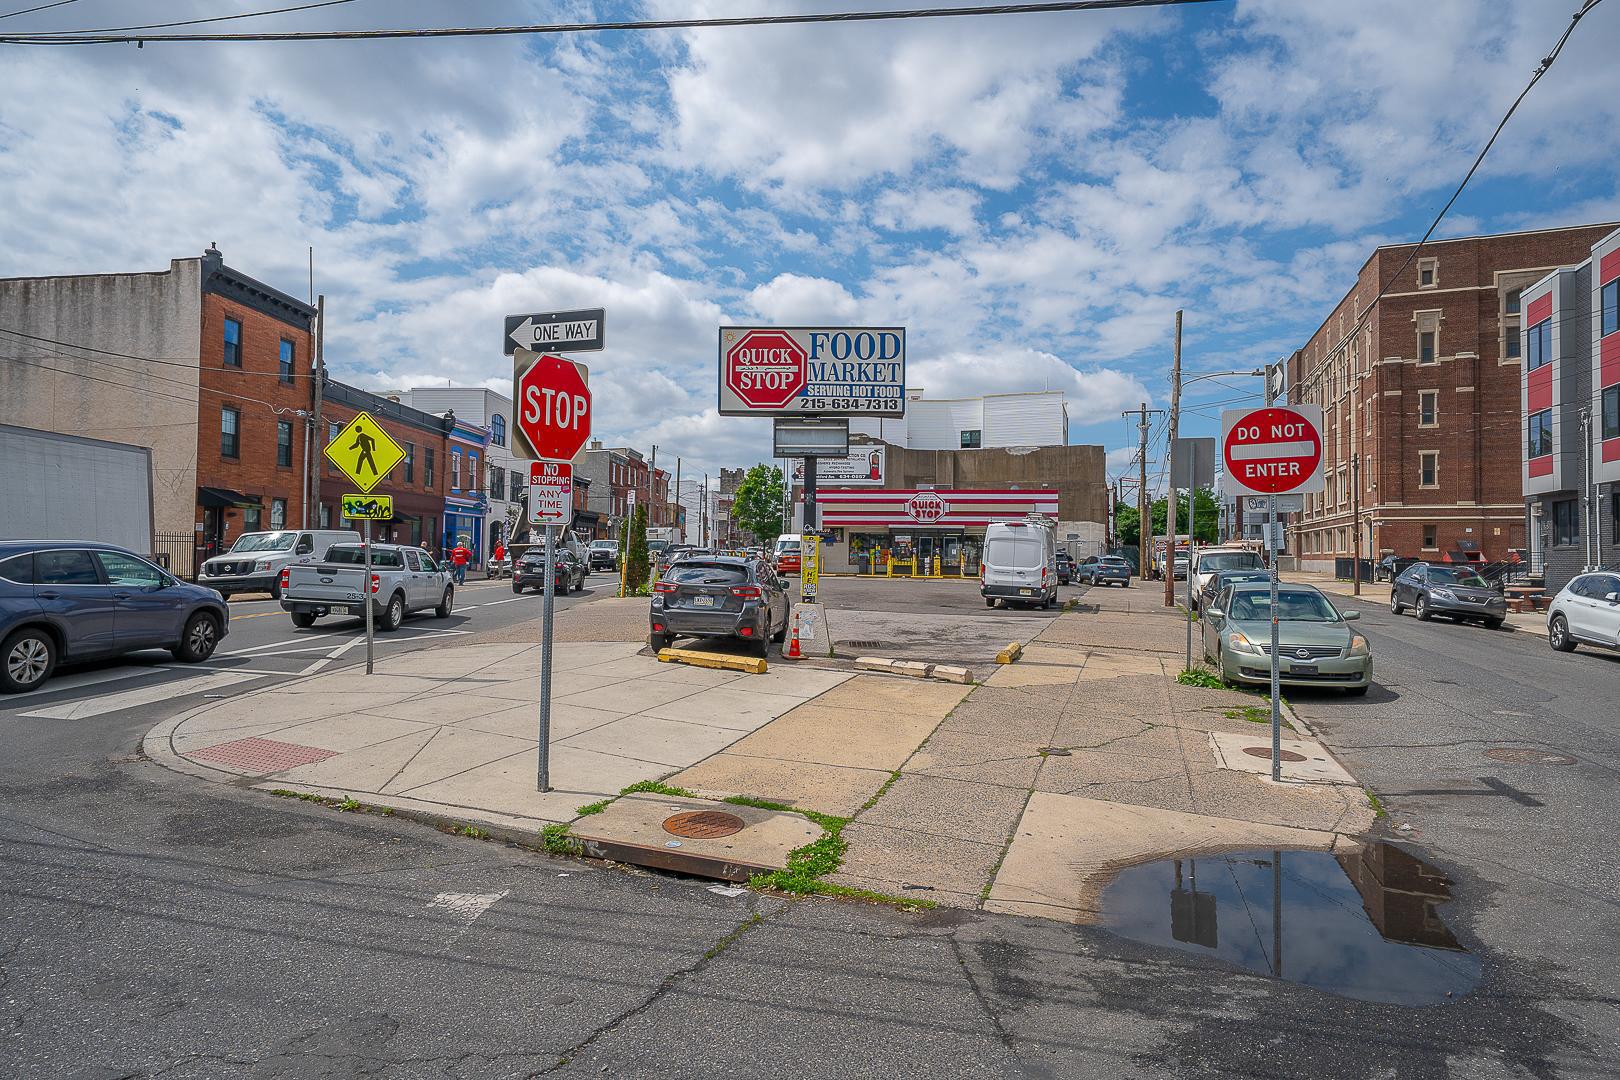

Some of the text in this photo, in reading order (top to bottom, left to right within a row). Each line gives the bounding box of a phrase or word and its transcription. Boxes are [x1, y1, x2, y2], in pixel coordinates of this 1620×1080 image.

[533, 322, 593, 341] ONE WAY
[808, 331, 901, 360] FOOD
[739, 348, 793, 365] QUICK
[807, 361, 901, 382] MARKET
[740, 371, 794, 390] STOP
[807, 384, 900, 398] SERVING HOT FOOD
[524, 384, 588, 431] STOP
[800, 398, 898, 410] 215-634-7313
[1237, 423, 1305, 440] DO NOT
[543, 463, 559, 476] NO
[1245, 462, 1300, 478] ENTER
[531, 475, 570, 485] STOPPING
[538, 490, 562, 498] ANY
[538, 499, 563, 509] TIME
[911, 500, 941, 510] QUICK
[915, 510, 941, 519] STOP
